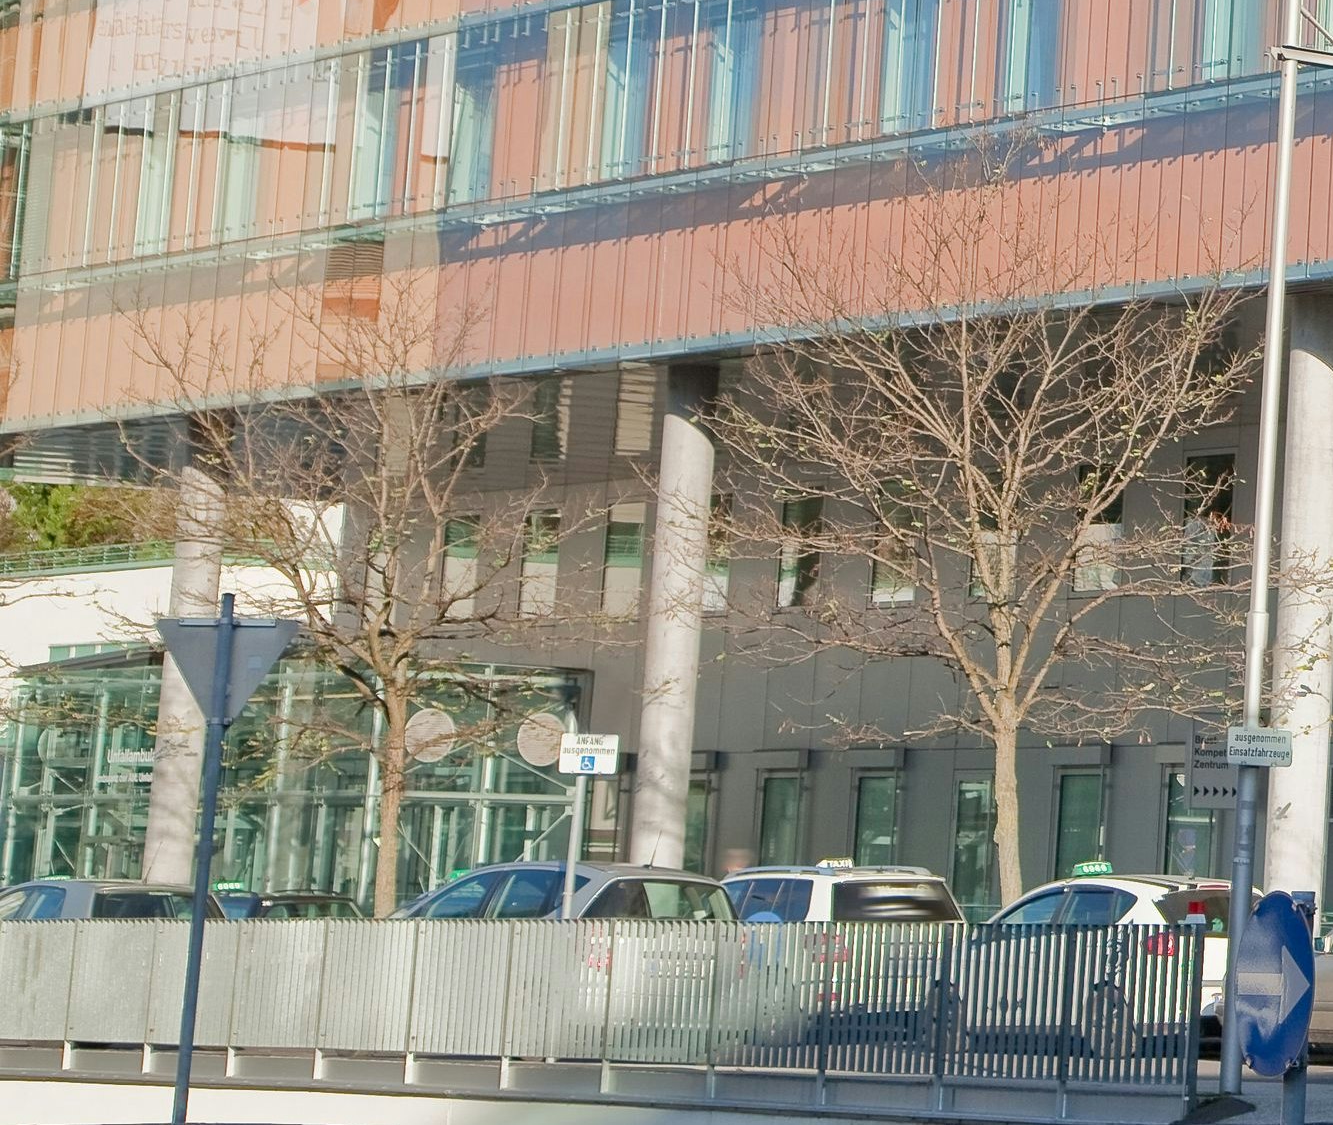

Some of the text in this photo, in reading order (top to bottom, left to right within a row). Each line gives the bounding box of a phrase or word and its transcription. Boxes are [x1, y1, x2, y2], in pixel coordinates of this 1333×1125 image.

[576, 736, 604, 746] ANFANG
[1234, 734, 1287, 744] ausgenommen
[562, 747, 616, 756] ausgenommen
[1229, 746, 1290, 759] Einsatzfahrzeuge
[1193, 760, 1229, 770] Zentrum
